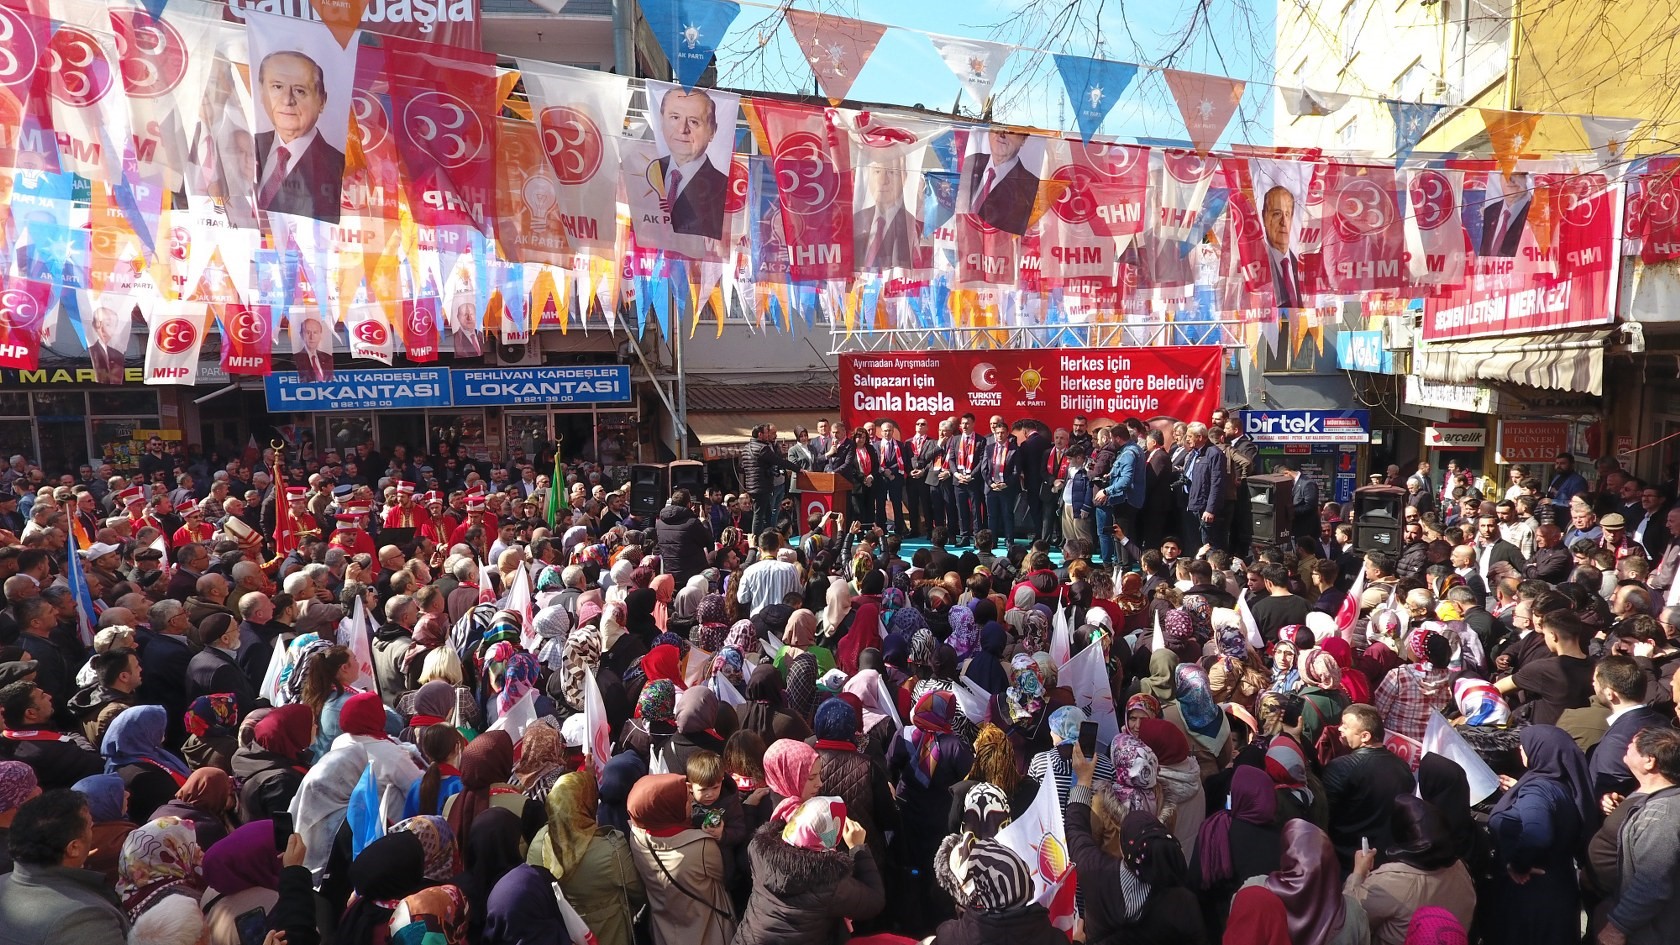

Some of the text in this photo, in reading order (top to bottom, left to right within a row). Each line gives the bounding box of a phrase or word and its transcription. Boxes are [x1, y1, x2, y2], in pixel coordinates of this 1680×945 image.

[643, 214, 659, 224] AK
[330, 227, 375, 244] MHP
[419, 228, 460, 245] MHP
[514, 235, 529, 245] AK
[759, 261, 777, 272] AK
[41, 272, 53, 280] AK
[1369, 300, 1395, 312] MHP
[1315, 307, 1338, 318] MHP
[358, 348, 388, 359] MHP
[411, 346, 433, 357] MHP
[228, 356, 264, 367] MHP
[1060, 356, 1131, 374] Herkes için
[152, 367, 190, 379] MHP
[354, 372, 439, 384] KARDEŞLER
[465, 369, 619, 381] PEHLİVAN KARDEŞLER
[853, 374, 935, 390] Salıpazarı için
[1060, 374, 1205, 394] Herkese göre Belediye
[280, 383, 440, 401] LOKANTASI
[465, 380, 620, 397] LOKANTASI
[363, 400, 377, 408] 39
[853, 391, 955, 416] Canla başla
[1060, 394, 1159, 413] Birliğin gücüyle
[1246, 412, 1320, 433] birtek
[1504, 426, 1566, 435] BİTKİ KORUMA
[1514, 435, 1556, 444] ÜRÜNLERİ
[1505, 444, 1561, 459] BAYİSİ
